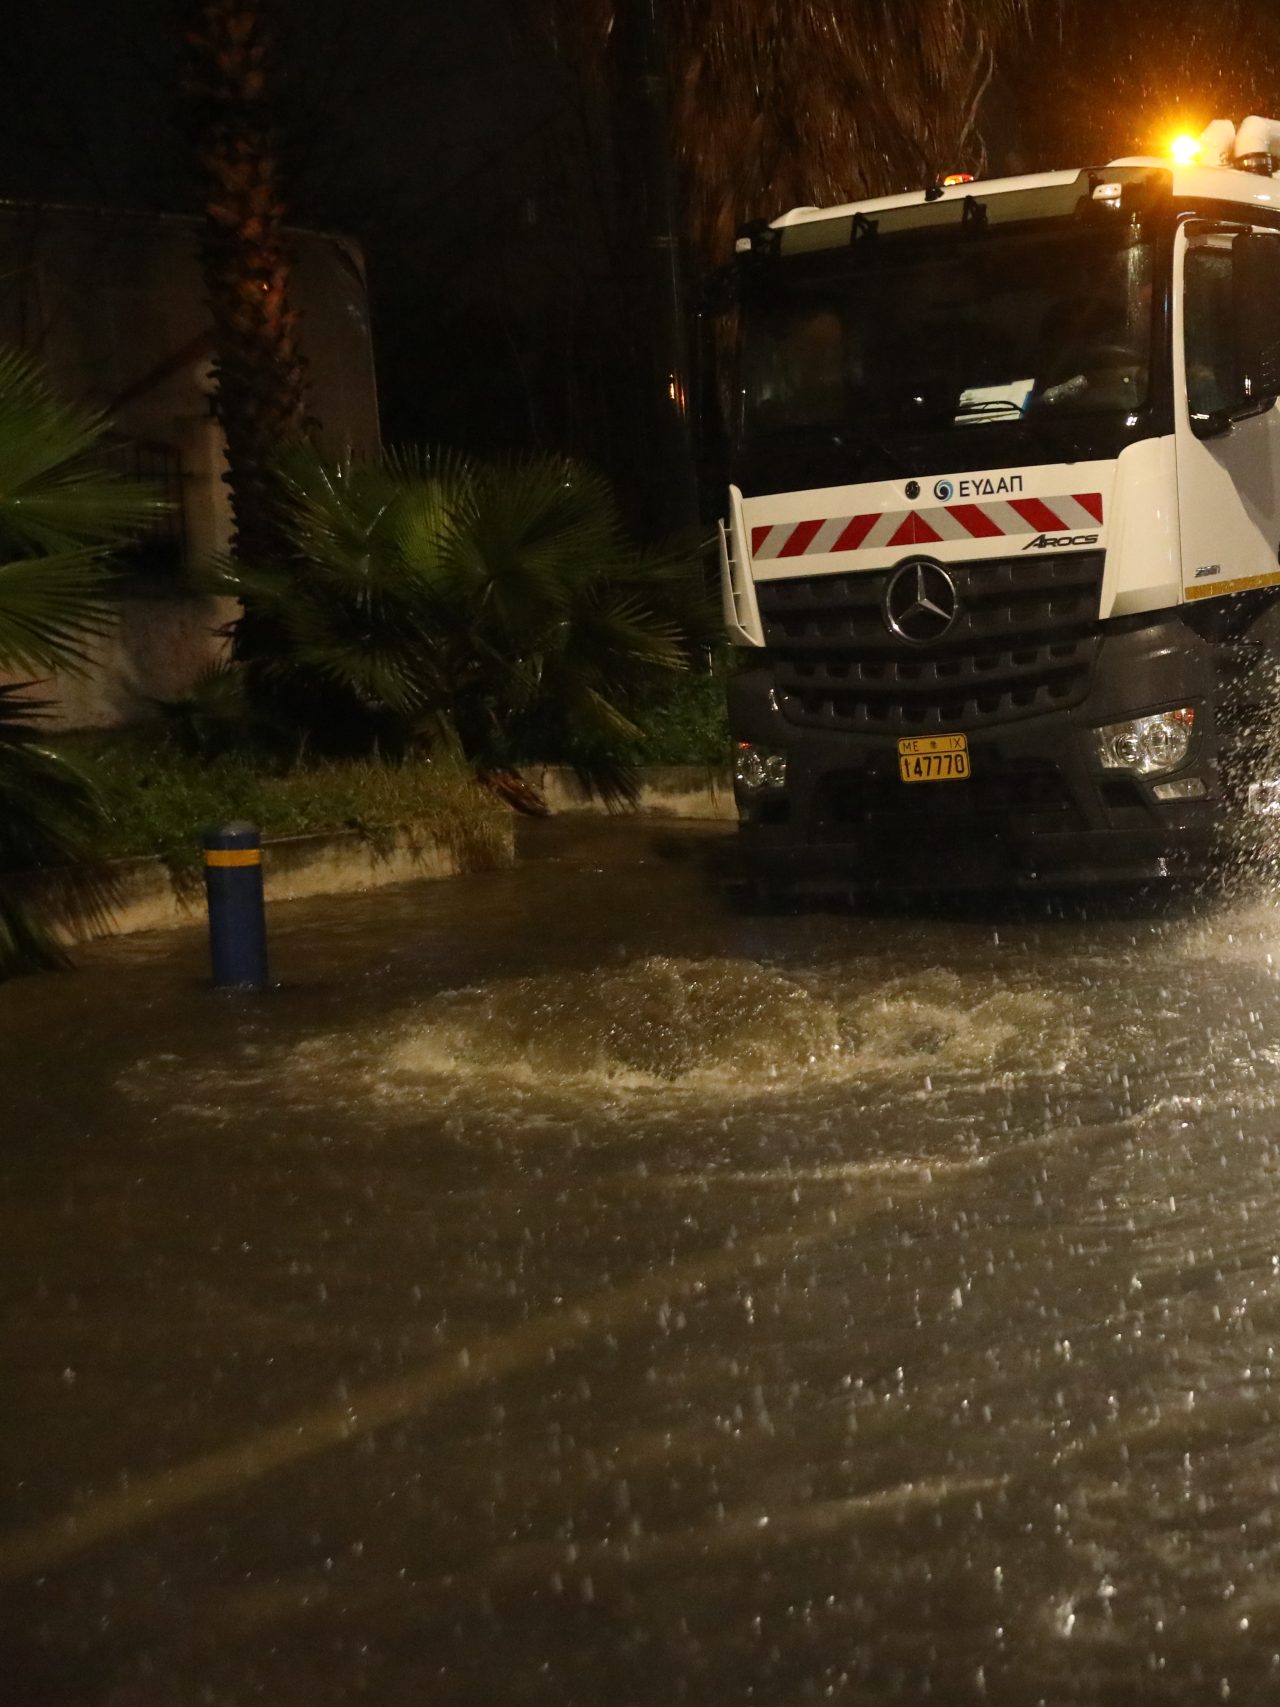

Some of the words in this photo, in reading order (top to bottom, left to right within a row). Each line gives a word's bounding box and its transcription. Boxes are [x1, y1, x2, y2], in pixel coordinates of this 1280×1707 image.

[959, 475, 1023, 497] ΕΥΔΑΠ
[903, 741, 919, 752] ME
[905, 754, 965, 778] 147770
